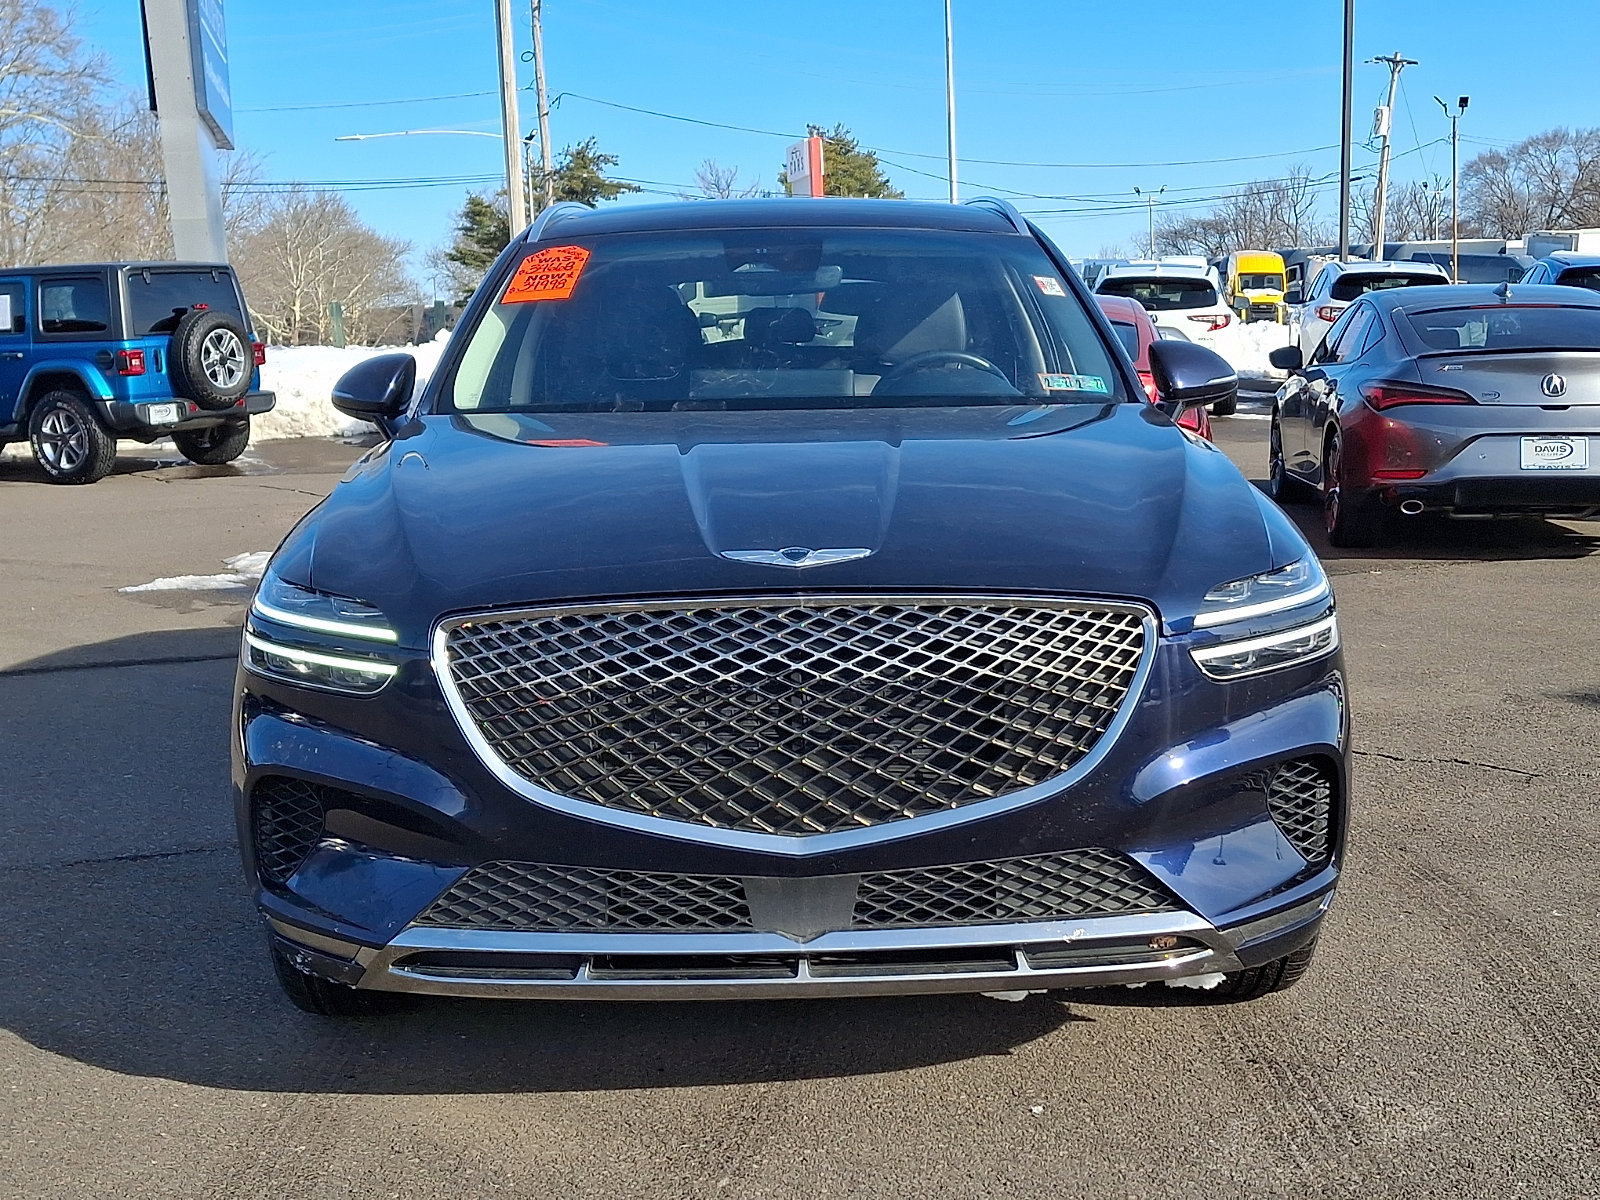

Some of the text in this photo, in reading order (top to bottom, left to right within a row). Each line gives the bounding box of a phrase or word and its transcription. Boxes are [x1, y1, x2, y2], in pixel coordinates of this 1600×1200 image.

[539, 255, 572, 264] WAS
[526, 272, 566, 282] NOW
[1534, 445, 1567, 453] DAVIS
